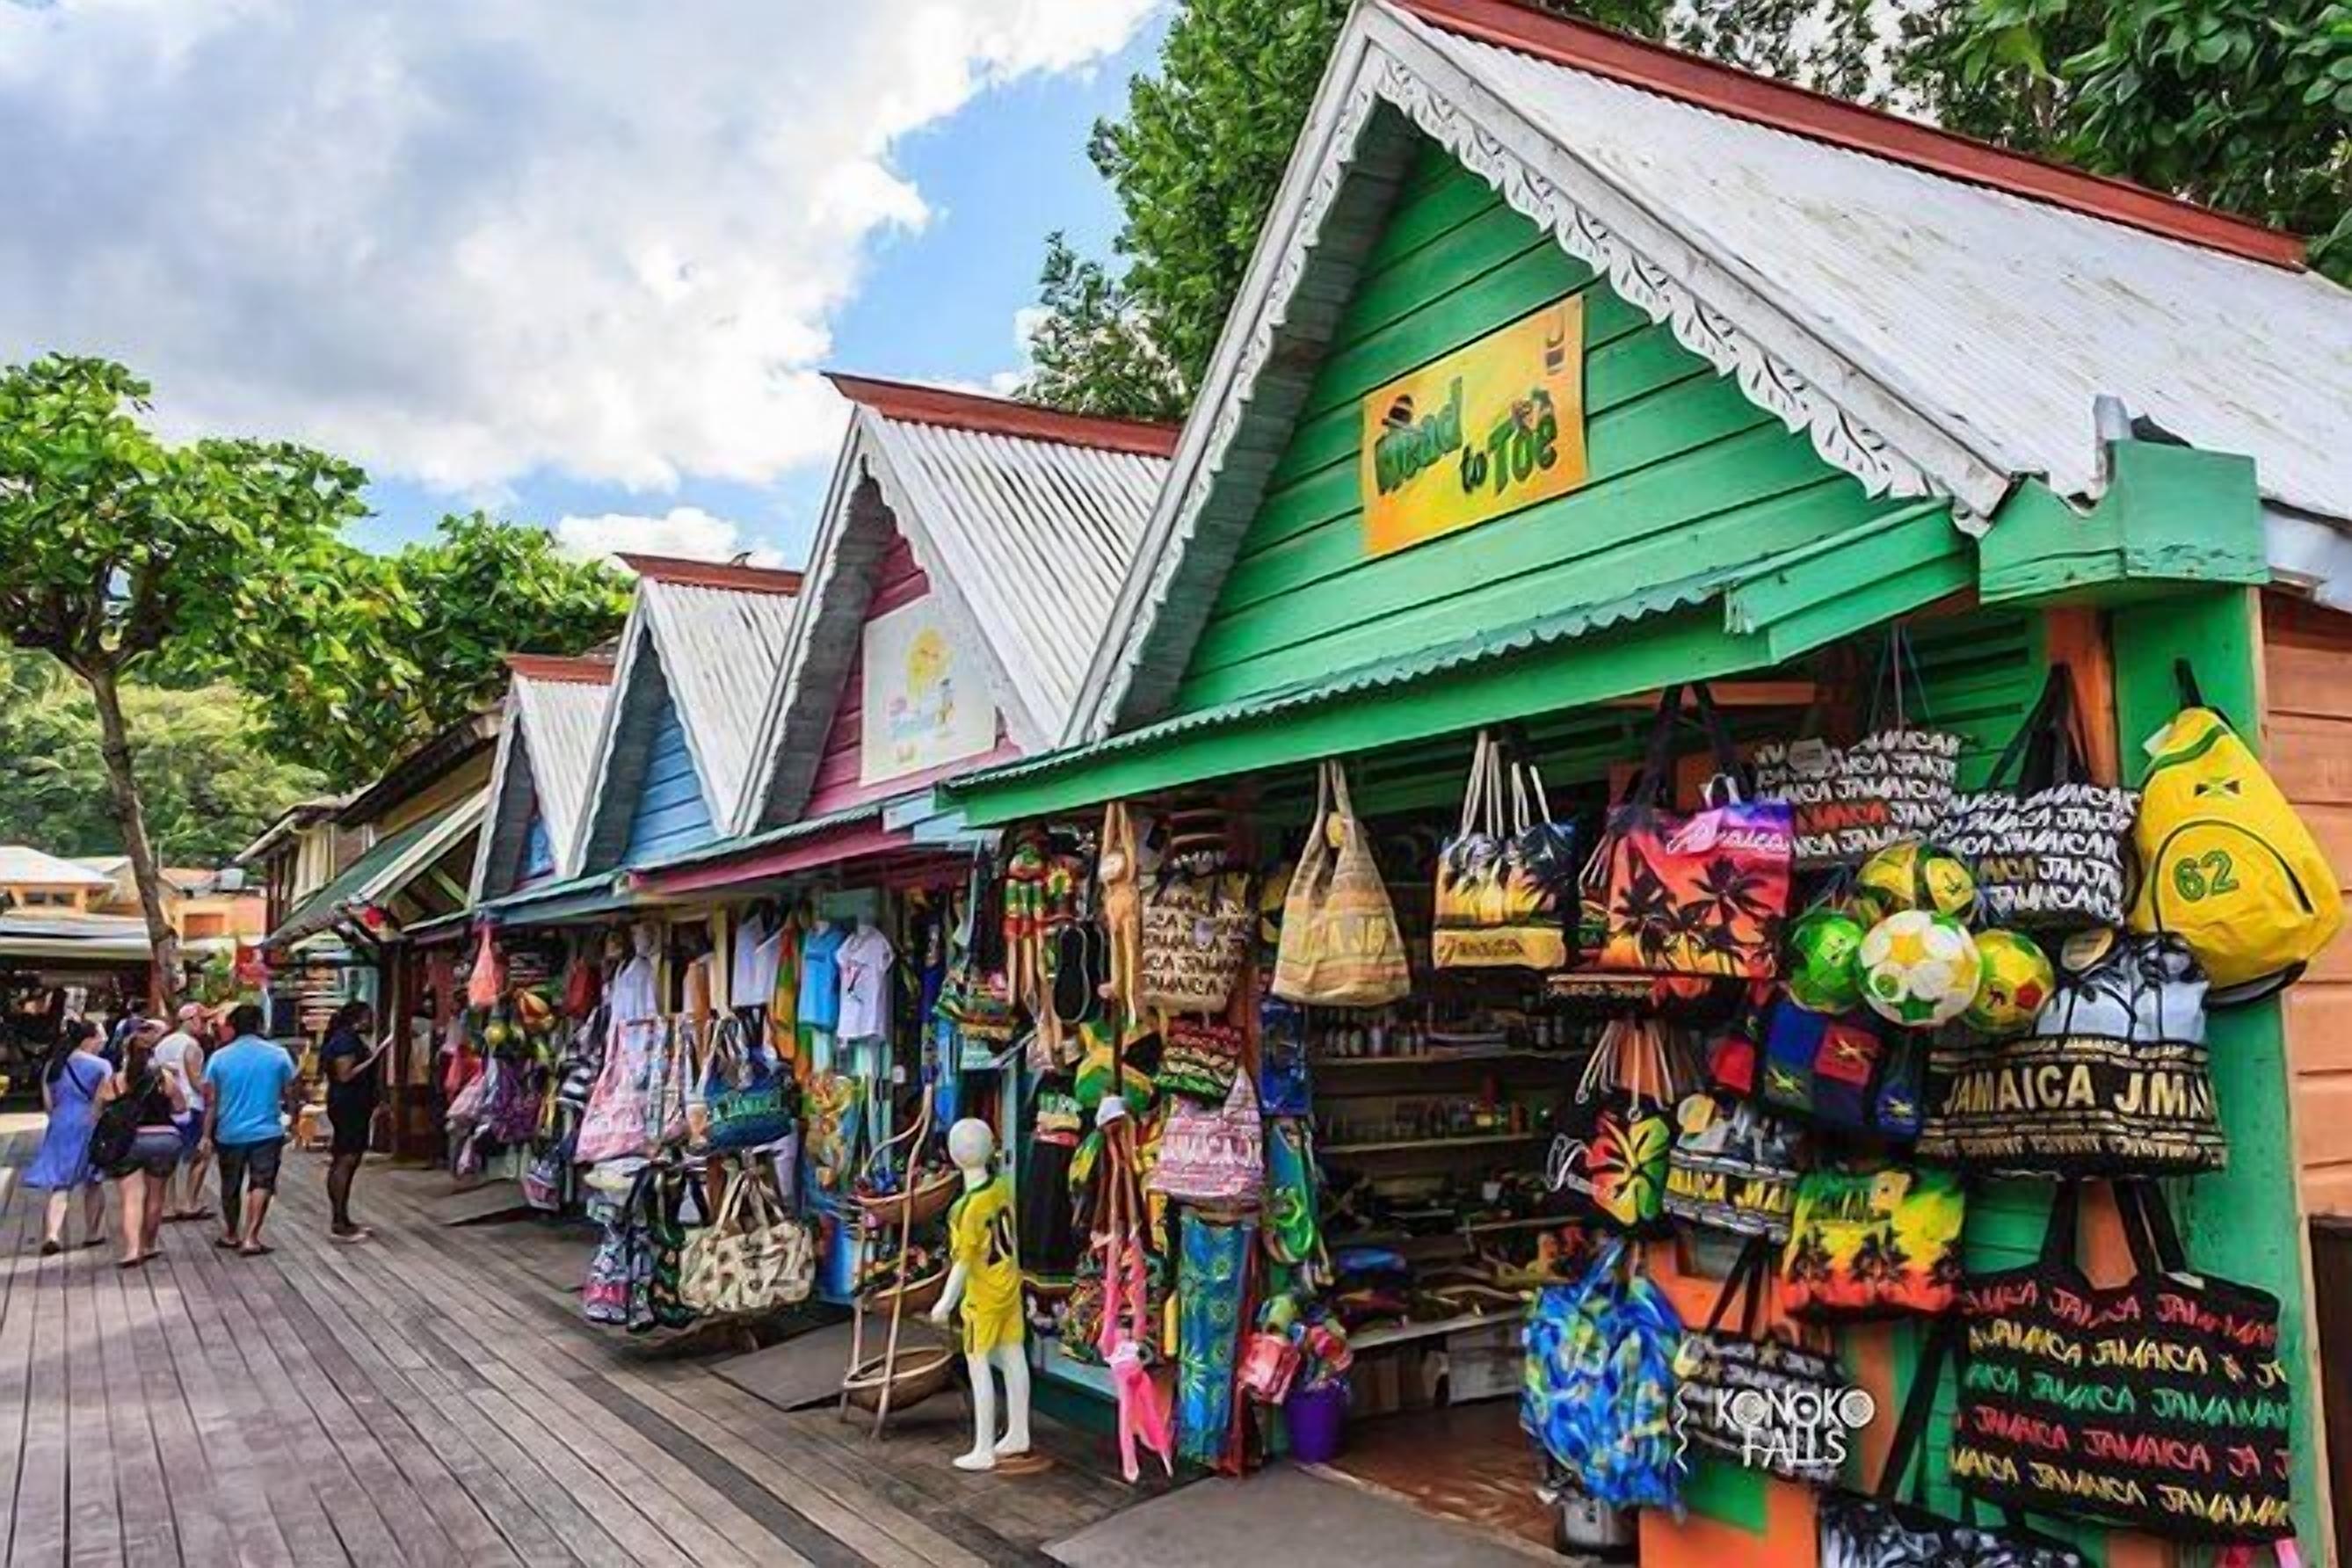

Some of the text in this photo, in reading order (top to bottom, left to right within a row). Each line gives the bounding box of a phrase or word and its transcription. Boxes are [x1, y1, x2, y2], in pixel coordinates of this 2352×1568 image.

[1460, 444, 1488, 494] to
[2174, 850, 2240, 904] 62
[1942, 1064, 2097, 1115] JAMAICA
